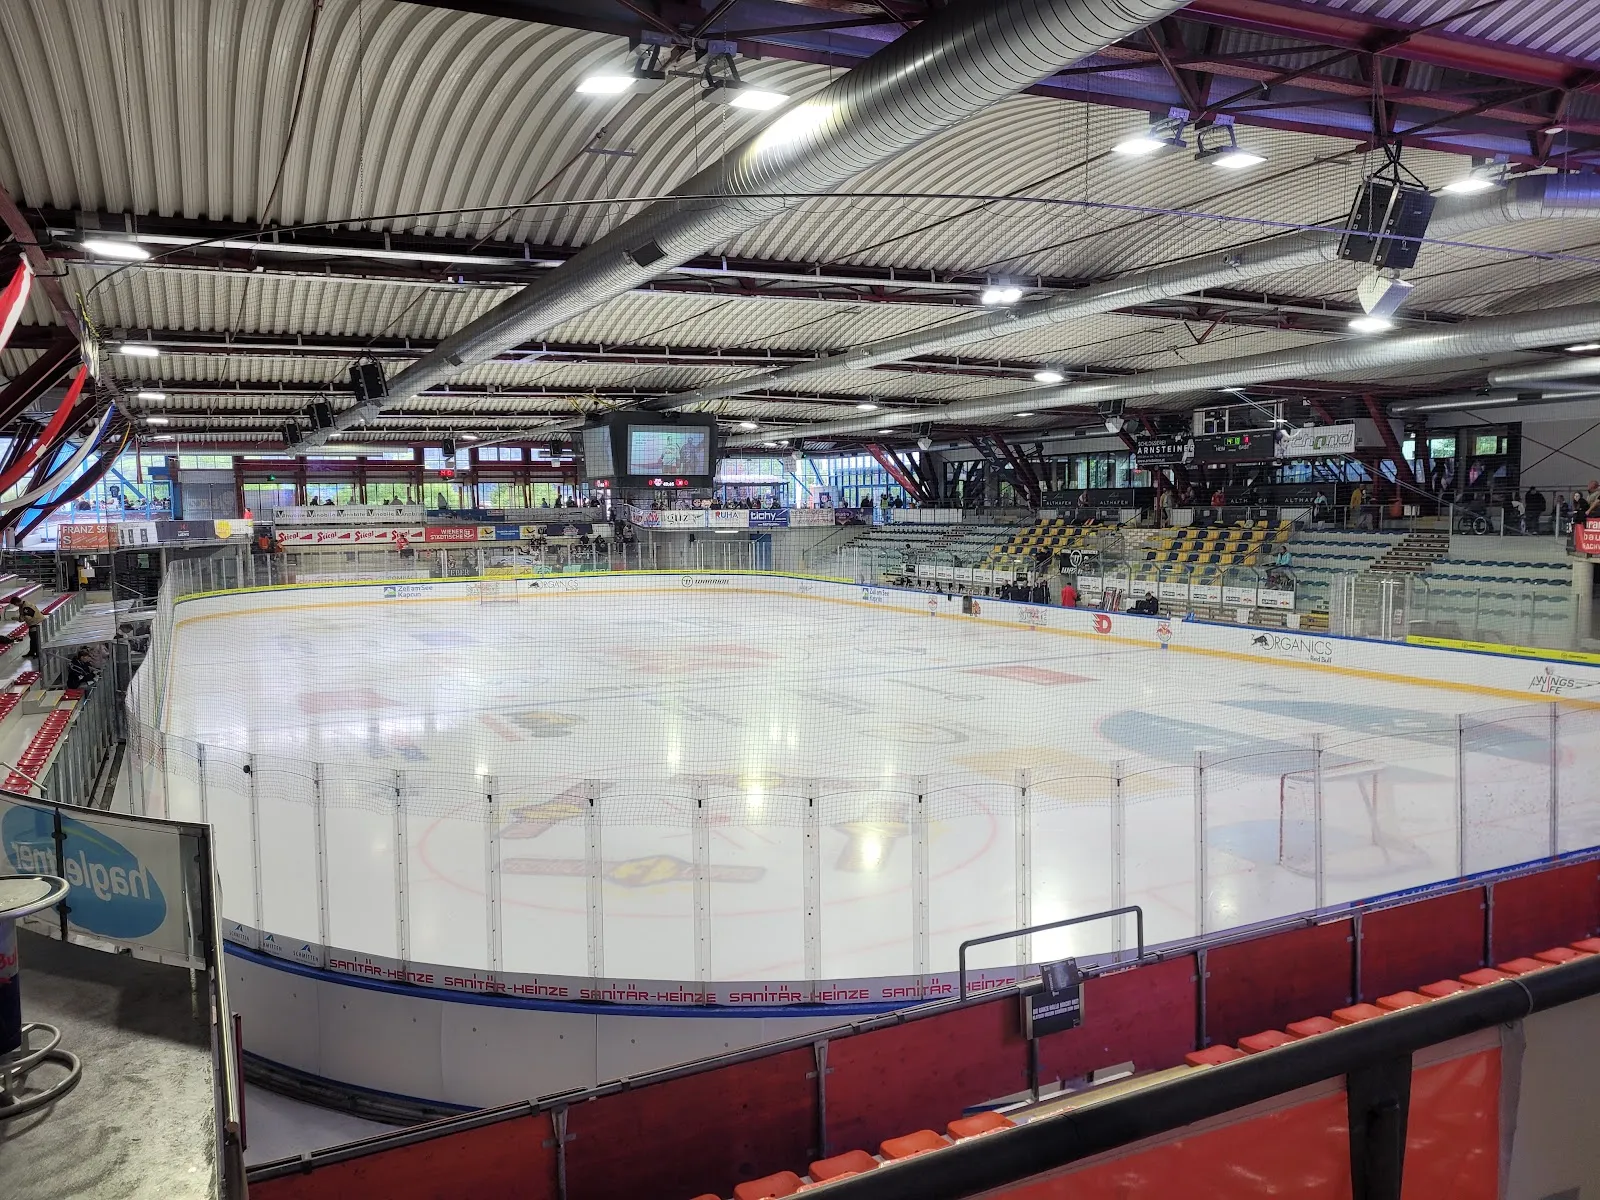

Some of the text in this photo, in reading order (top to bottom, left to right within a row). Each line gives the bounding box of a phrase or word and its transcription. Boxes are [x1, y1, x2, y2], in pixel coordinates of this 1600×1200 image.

[1137, 444, 1195, 454] ARNSTEINER
[715, 511, 739, 519] RUHA
[750, 512, 776, 521] tichy
[62, 526, 95, 534] FRANZ
[278, 532, 299, 543] Stiegl
[317, 531, 338, 543] Stiegl
[354, 530, 375, 542] Stiegl
[1261, 633, 1333, 656] ORGANICS
[1321, 655, 1333, 664] Bull
[1536, 674, 1575, 688] WINGS
[1540, 682, 1563, 695] LIFE
[293, 950, 319, 962] SCHMITTEN
